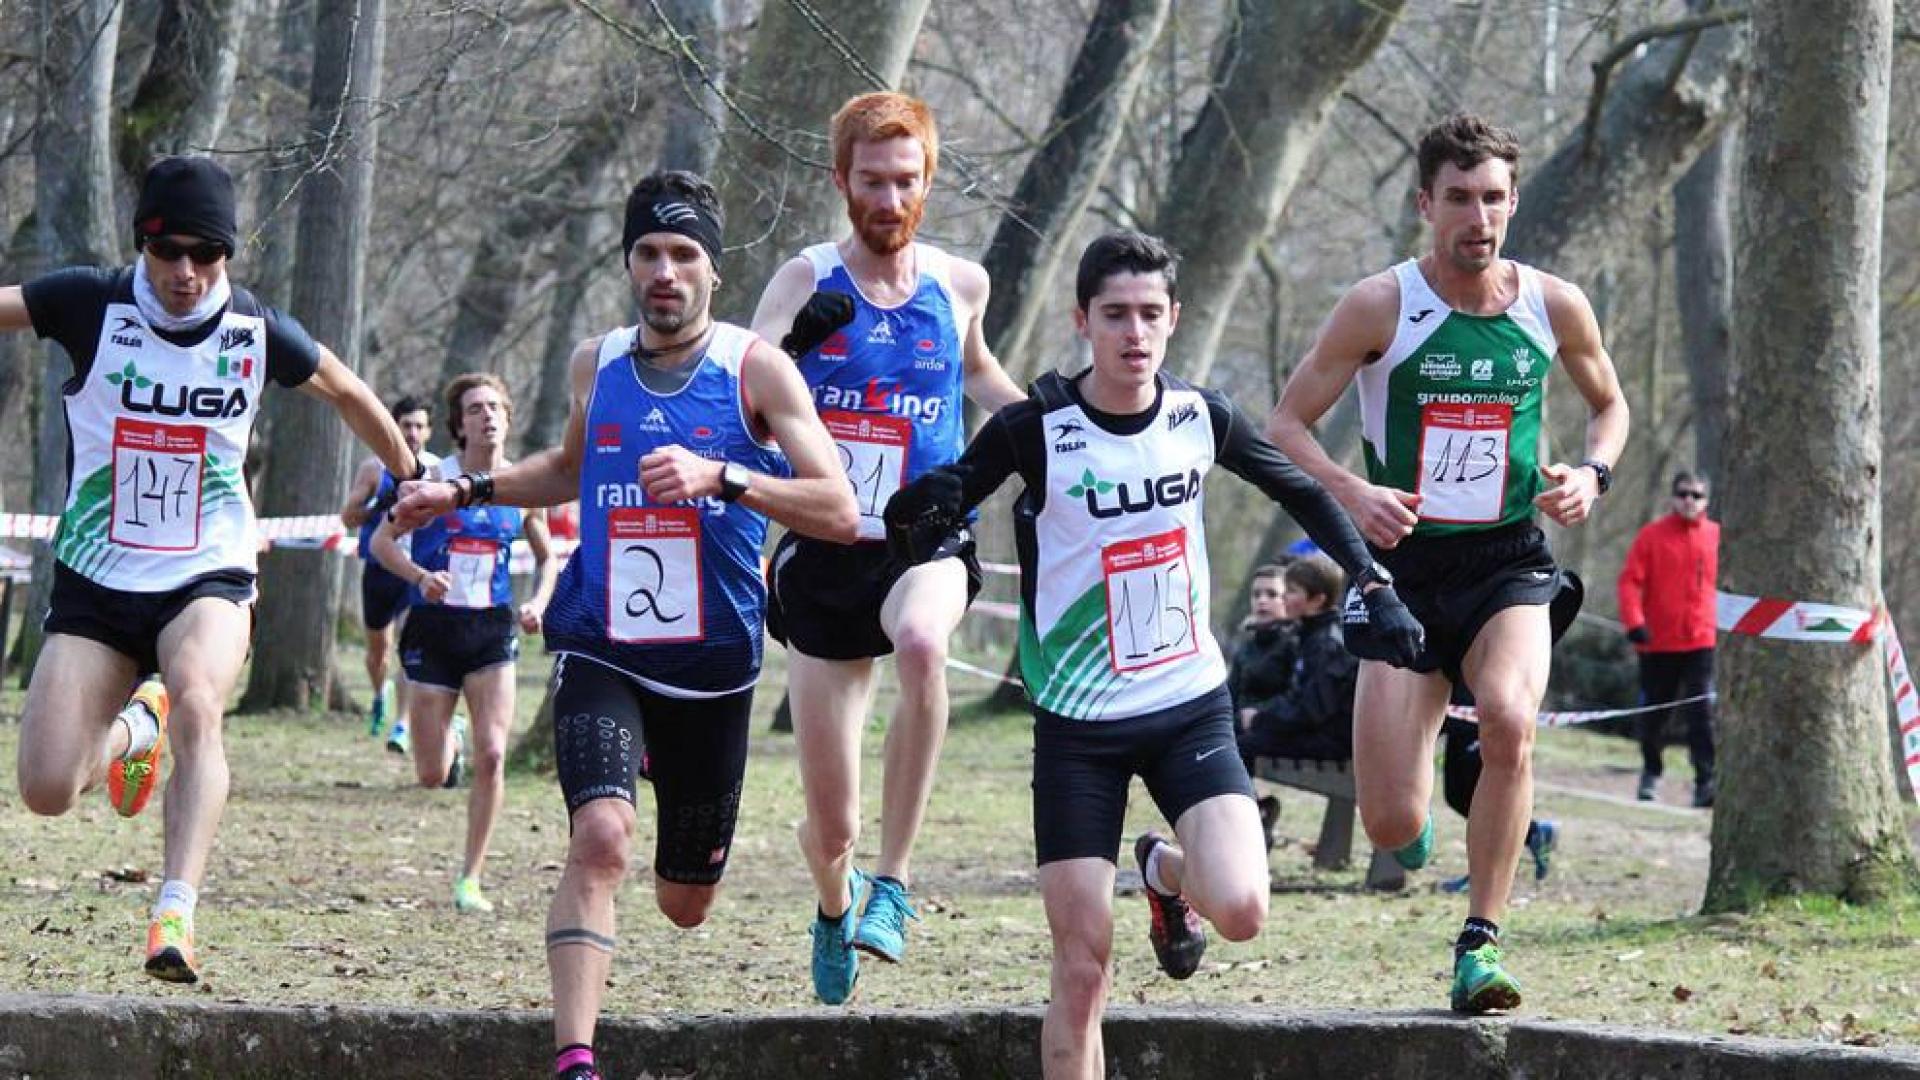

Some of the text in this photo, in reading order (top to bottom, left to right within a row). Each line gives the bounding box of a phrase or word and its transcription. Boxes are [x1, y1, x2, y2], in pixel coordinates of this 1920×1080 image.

[121, 379, 249, 418] LUGA
[811, 377, 942, 424] ranking
[1432, 433, 1498, 483] 113
[120, 456, 195, 528] 147
[1086, 468, 1200, 518] LUGA
[622, 544, 686, 623] 2
[1114, 561, 1188, 660] 115
